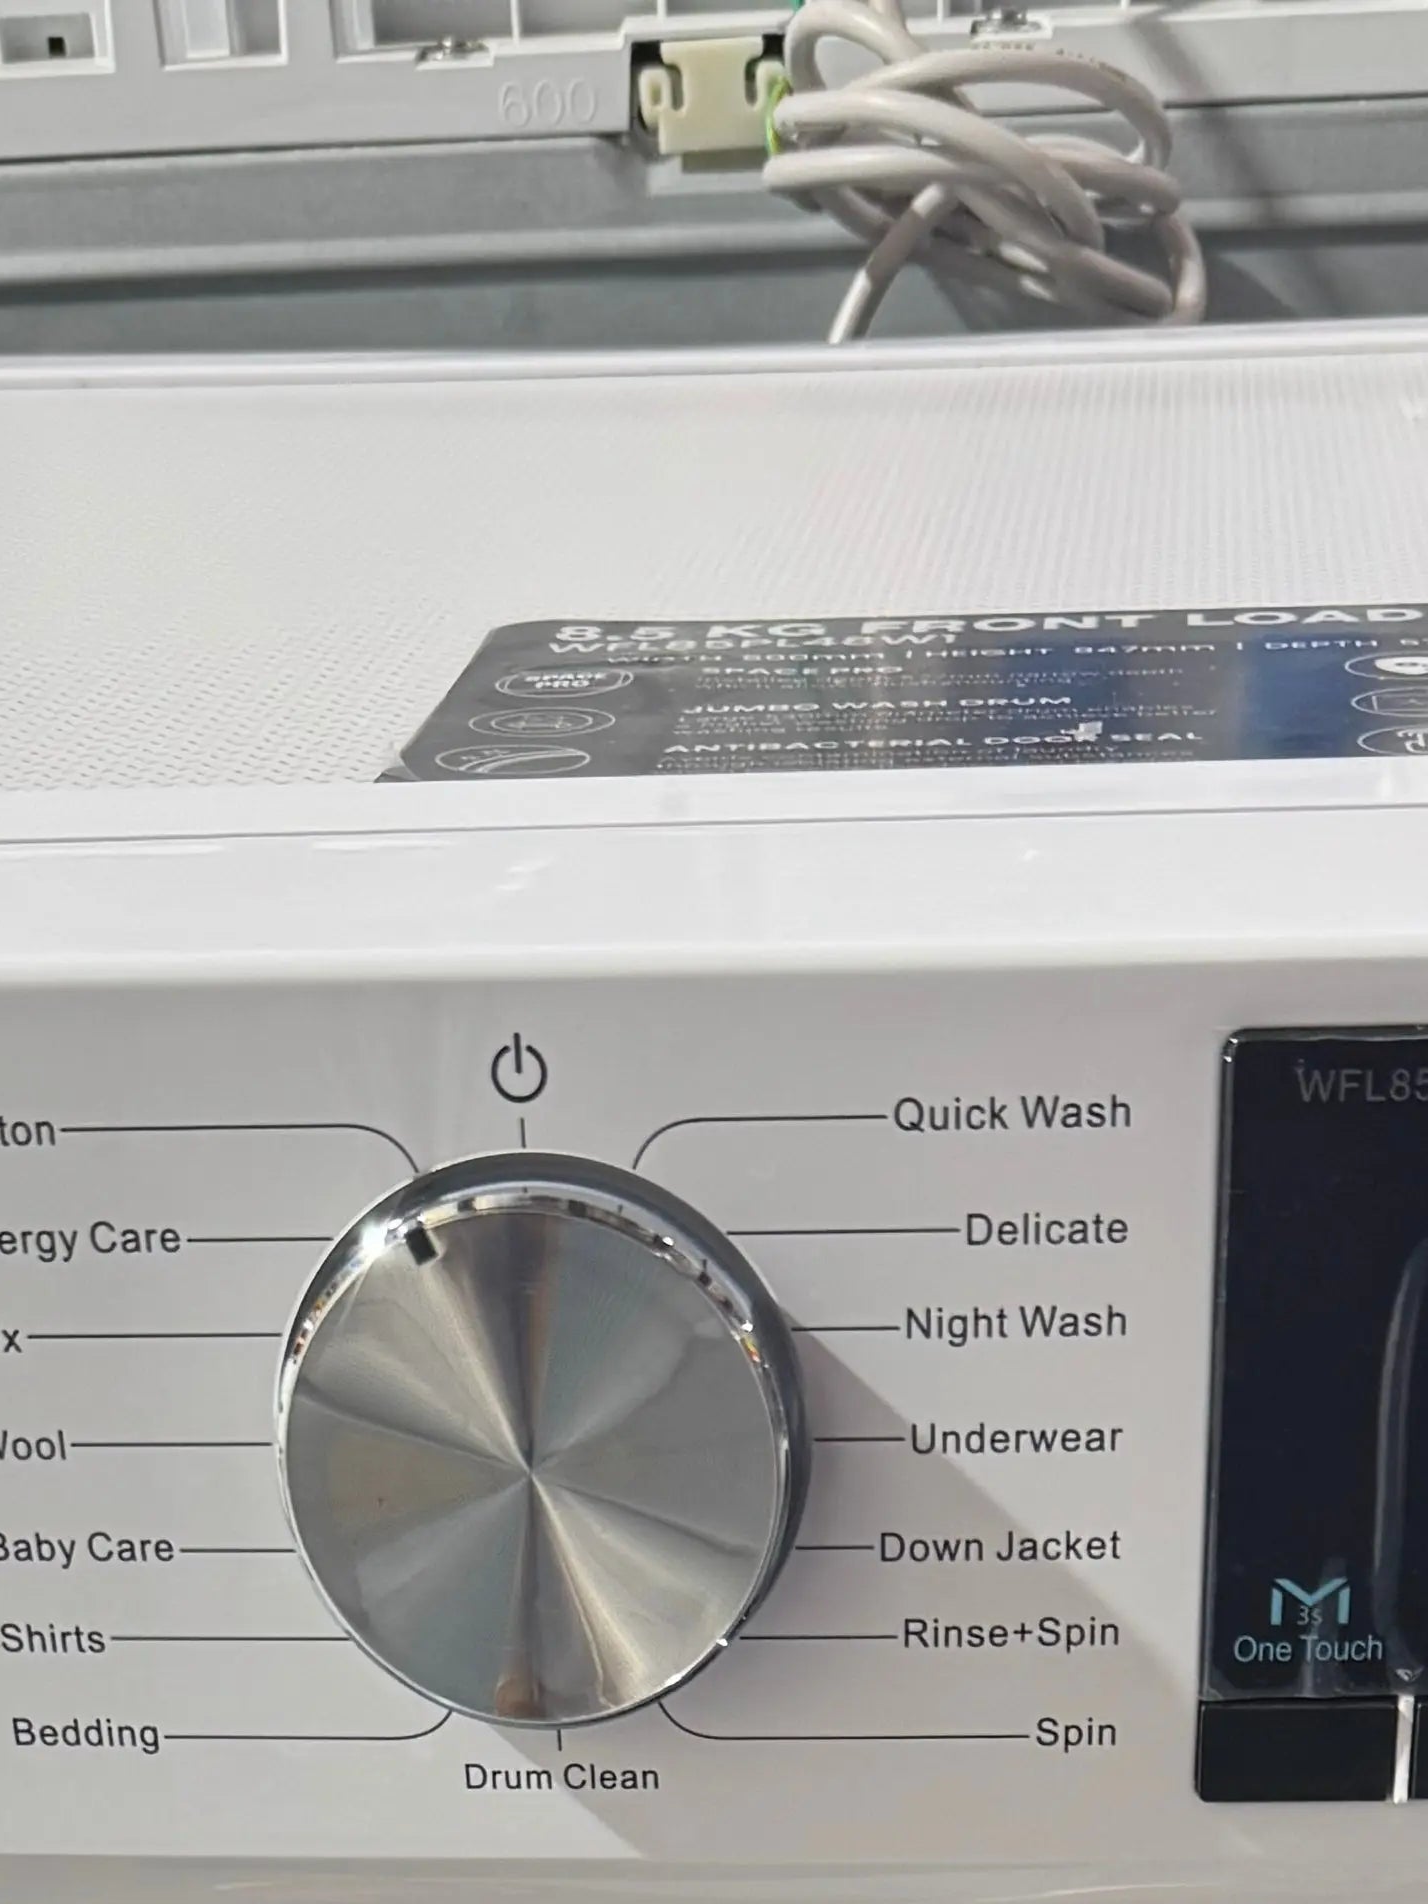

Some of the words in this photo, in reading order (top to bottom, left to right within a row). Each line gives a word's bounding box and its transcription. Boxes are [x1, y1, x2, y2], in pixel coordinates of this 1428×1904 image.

[499, 76, 598, 127] 600
[556, 626, 676, 642] 8.5
[705, 623, 827, 639] KG
[860, 615, 1155, 634] FRONT
[1186, 608, 1423, 626] LOAD
[925, 647, 1052, 658] HEIGHT
[1075, 645, 1215, 654] 847mm
[1265, 639, 1379, 650] DEPTH
[535, 680, 589, 689] PRO
[702, 667, 818, 675] SPACE
[830, 666, 903, 674] PRO
[682, 703, 820, 714] JUMBO
[831, 699, 948, 709] WASH
[959, 697, 1071, 707] DRUM
[664, 737, 972, 754] ANTIBACTERIAL
[1109, 731, 1203, 741] SEAL
[894, 1096, 1010, 1133] Quick
[1020, 1094, 1132, 1128] Wash
[90, 1221, 181, 1253] Care
[965, 1212, 1129, 1247] Delicate
[905, 1306, 1009, 1348] Night
[1019, 1304, 1128, 1338] Wash
[910, 1422, 1124, 1455] Underwear
[87, 1532, 175, 1563] Care
[879, 1531, 984, 1562] Down
[995, 1529, 1121, 1561] Jacket
[0, 1623, 106, 1655] Shirts
[903, 1616, 1121, 1654] Rinse+Spin
[1232, 1635, 1292, 1663] One
[1302, 1634, 1385, 1662] Touch
[12, 1719, 160, 1755] Bedding
[1035, 1717, 1117, 1753] Spin
[463, 1764, 553, 1790] Drum
[563, 1763, 660, 1790] Clean
